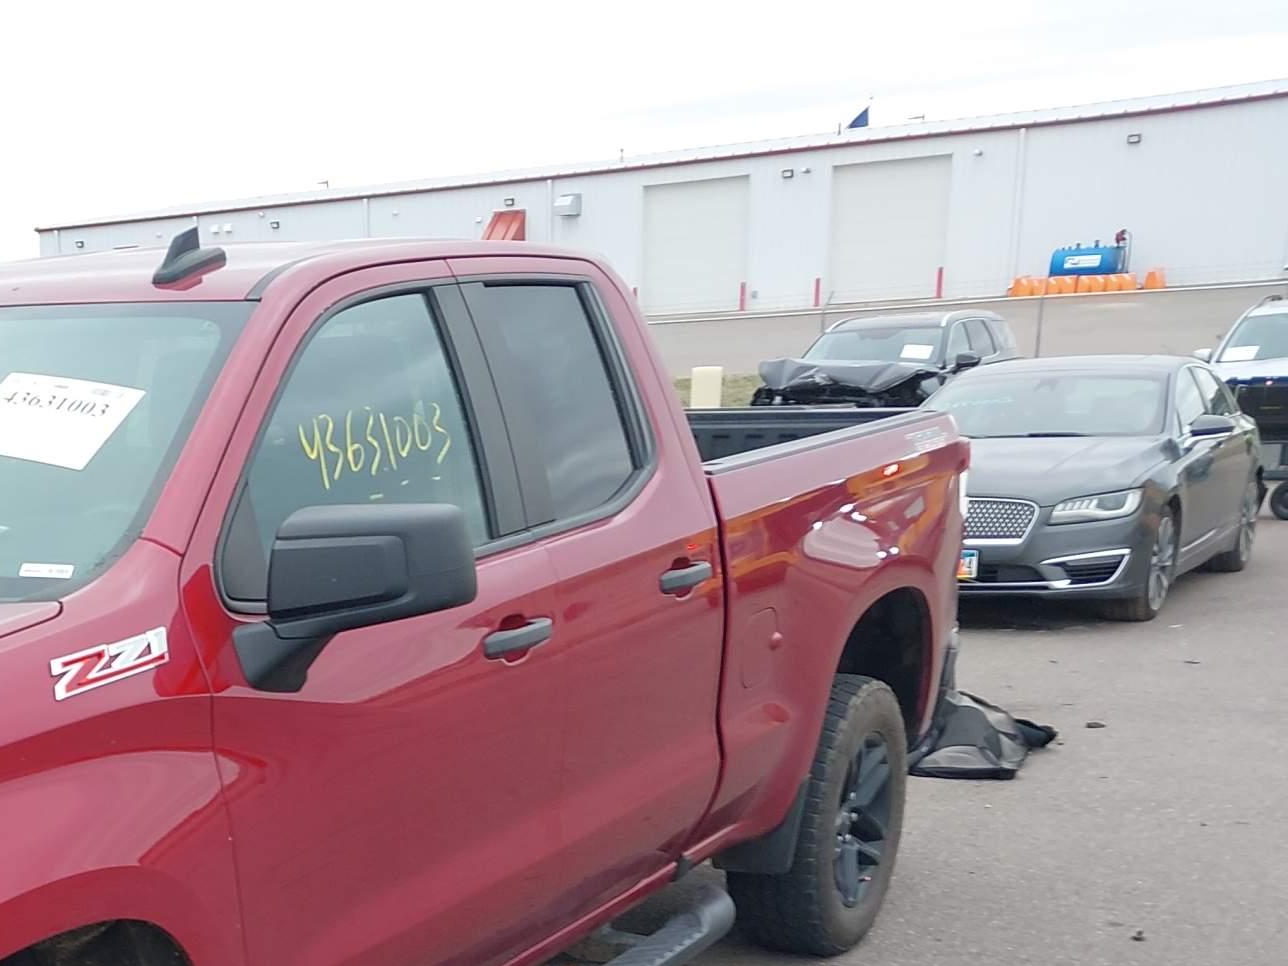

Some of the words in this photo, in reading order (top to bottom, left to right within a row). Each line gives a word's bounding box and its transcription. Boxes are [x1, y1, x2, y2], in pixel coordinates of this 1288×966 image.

[3, 391, 111, 418] 43631003
[298, 402, 451, 490] 43631003
[50, 626, 169, 701] Z71
